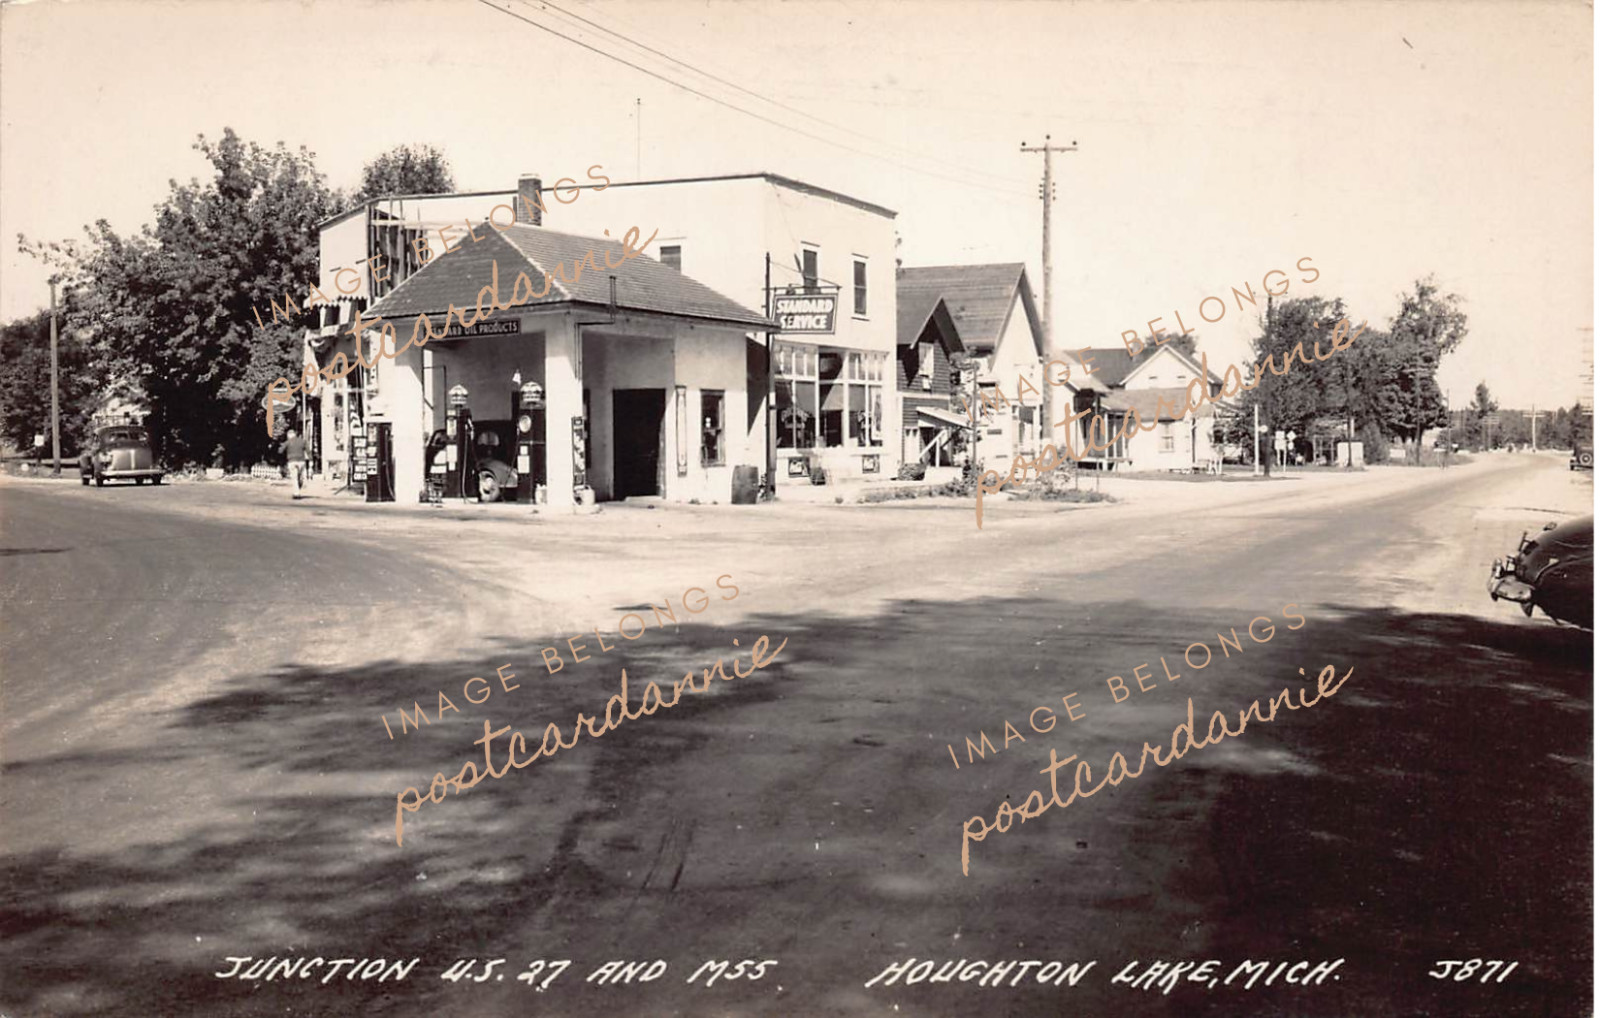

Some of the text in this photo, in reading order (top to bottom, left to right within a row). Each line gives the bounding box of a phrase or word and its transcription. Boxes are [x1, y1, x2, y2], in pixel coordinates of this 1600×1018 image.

[776, 299, 834, 314] STANDARD
[479, 321, 517, 332] PRODUCTS
[780, 315, 828, 330] SERVICE
